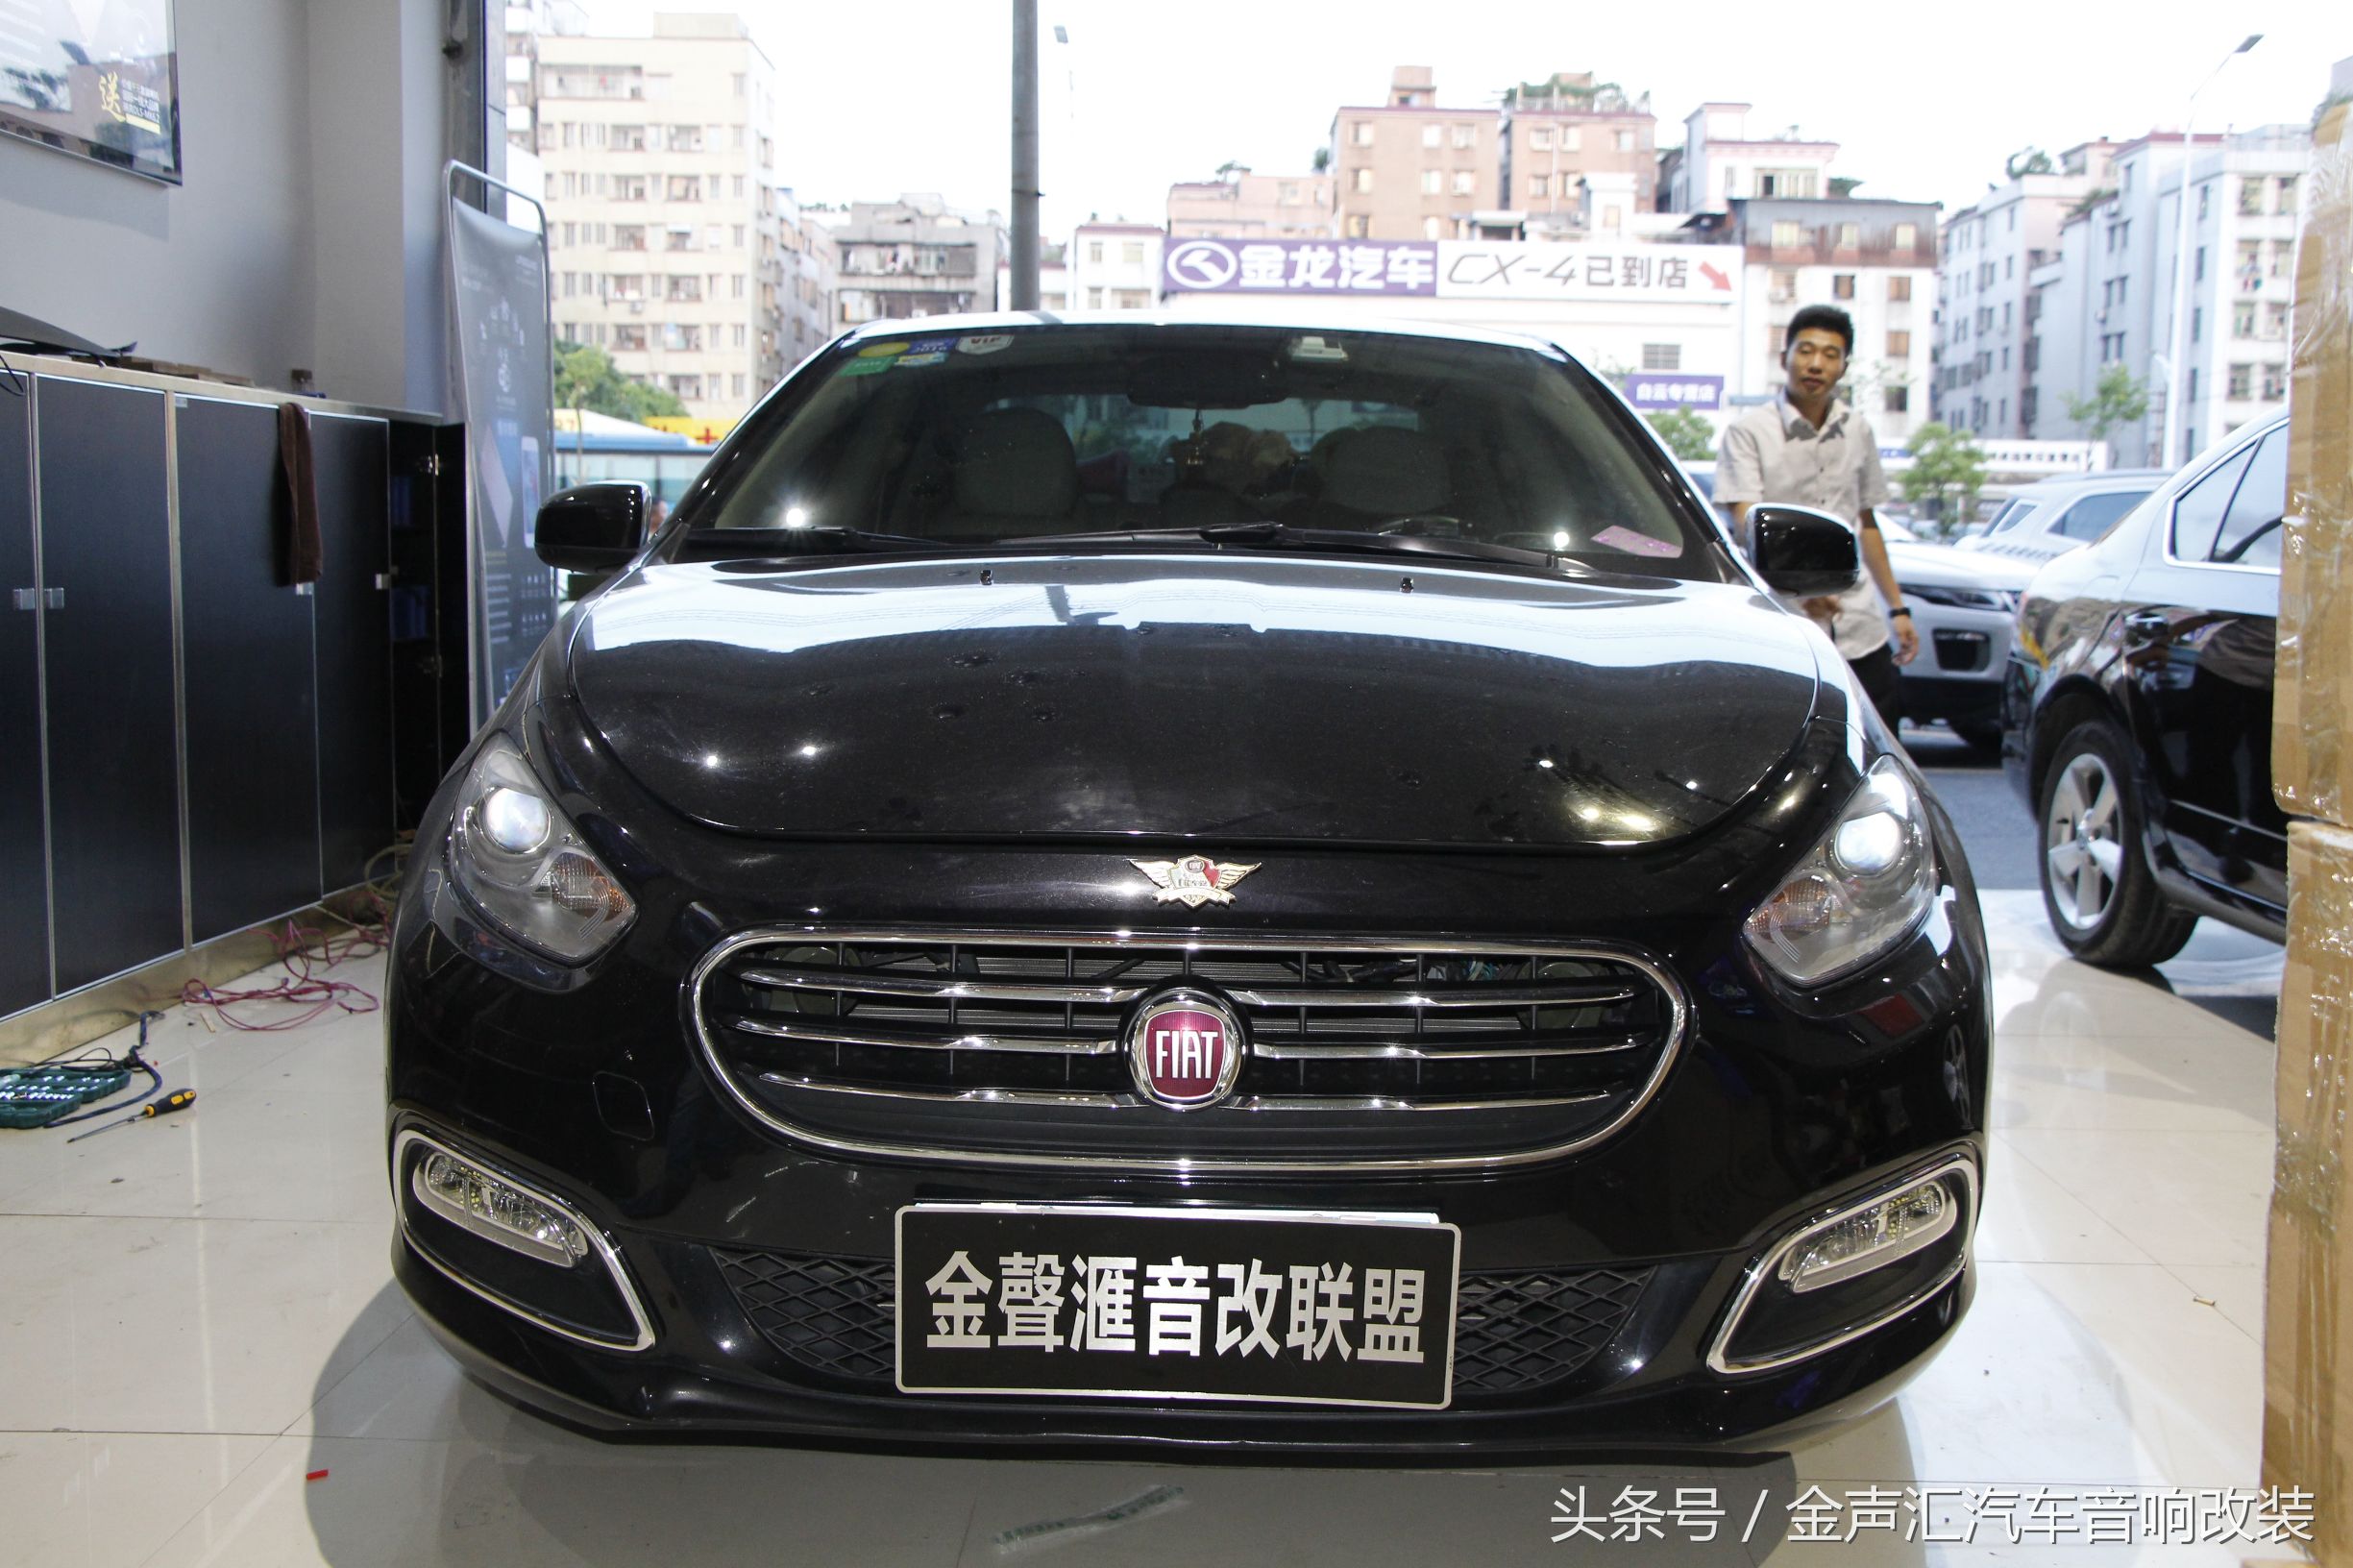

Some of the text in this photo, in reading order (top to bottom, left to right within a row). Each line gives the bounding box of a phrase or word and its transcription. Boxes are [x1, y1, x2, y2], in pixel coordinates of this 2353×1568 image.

[1238, 244, 1434, 290] 金龙汽车
[1447, 254, 1689, 288] CX-4已到店
[1156, 1030, 1218, 1079] FIAT
[924, 1251, 1425, 1363] 金聲滙音改联盟
